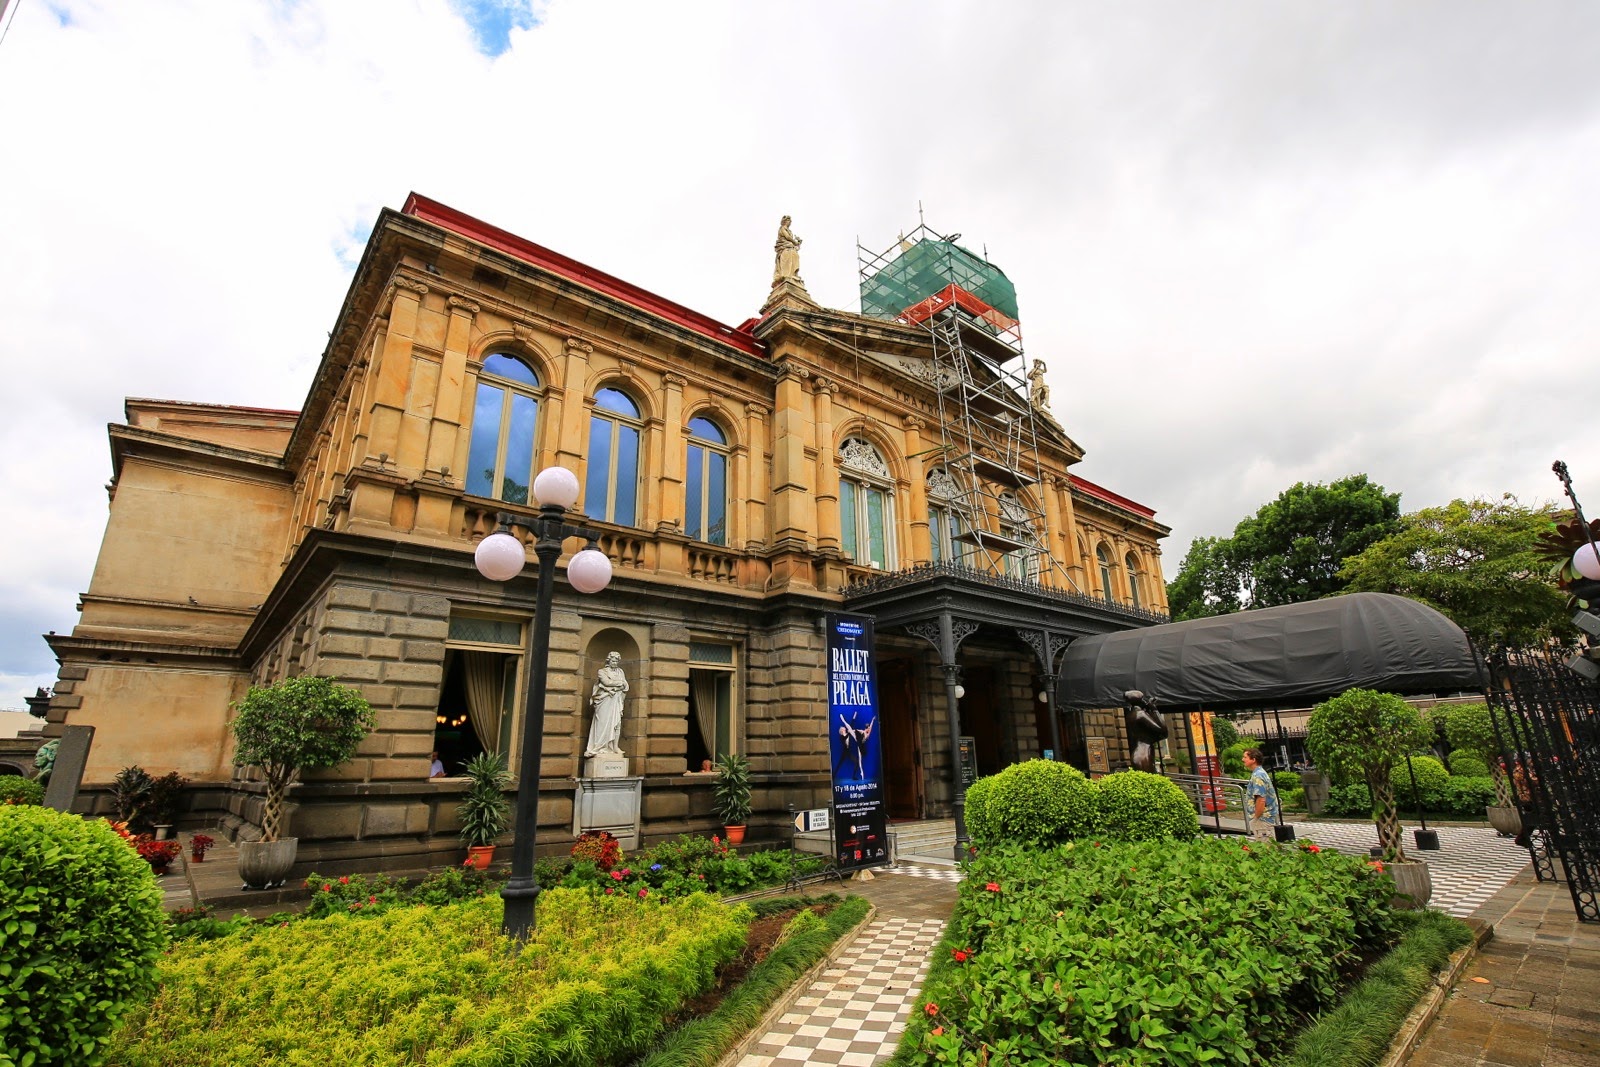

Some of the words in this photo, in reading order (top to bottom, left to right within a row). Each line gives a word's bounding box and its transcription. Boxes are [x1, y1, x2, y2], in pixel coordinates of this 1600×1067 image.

[893, 388, 942, 418] TEATRO
[832, 647, 869, 674] BALLET
[832, 680, 871, 706] PRAGA
